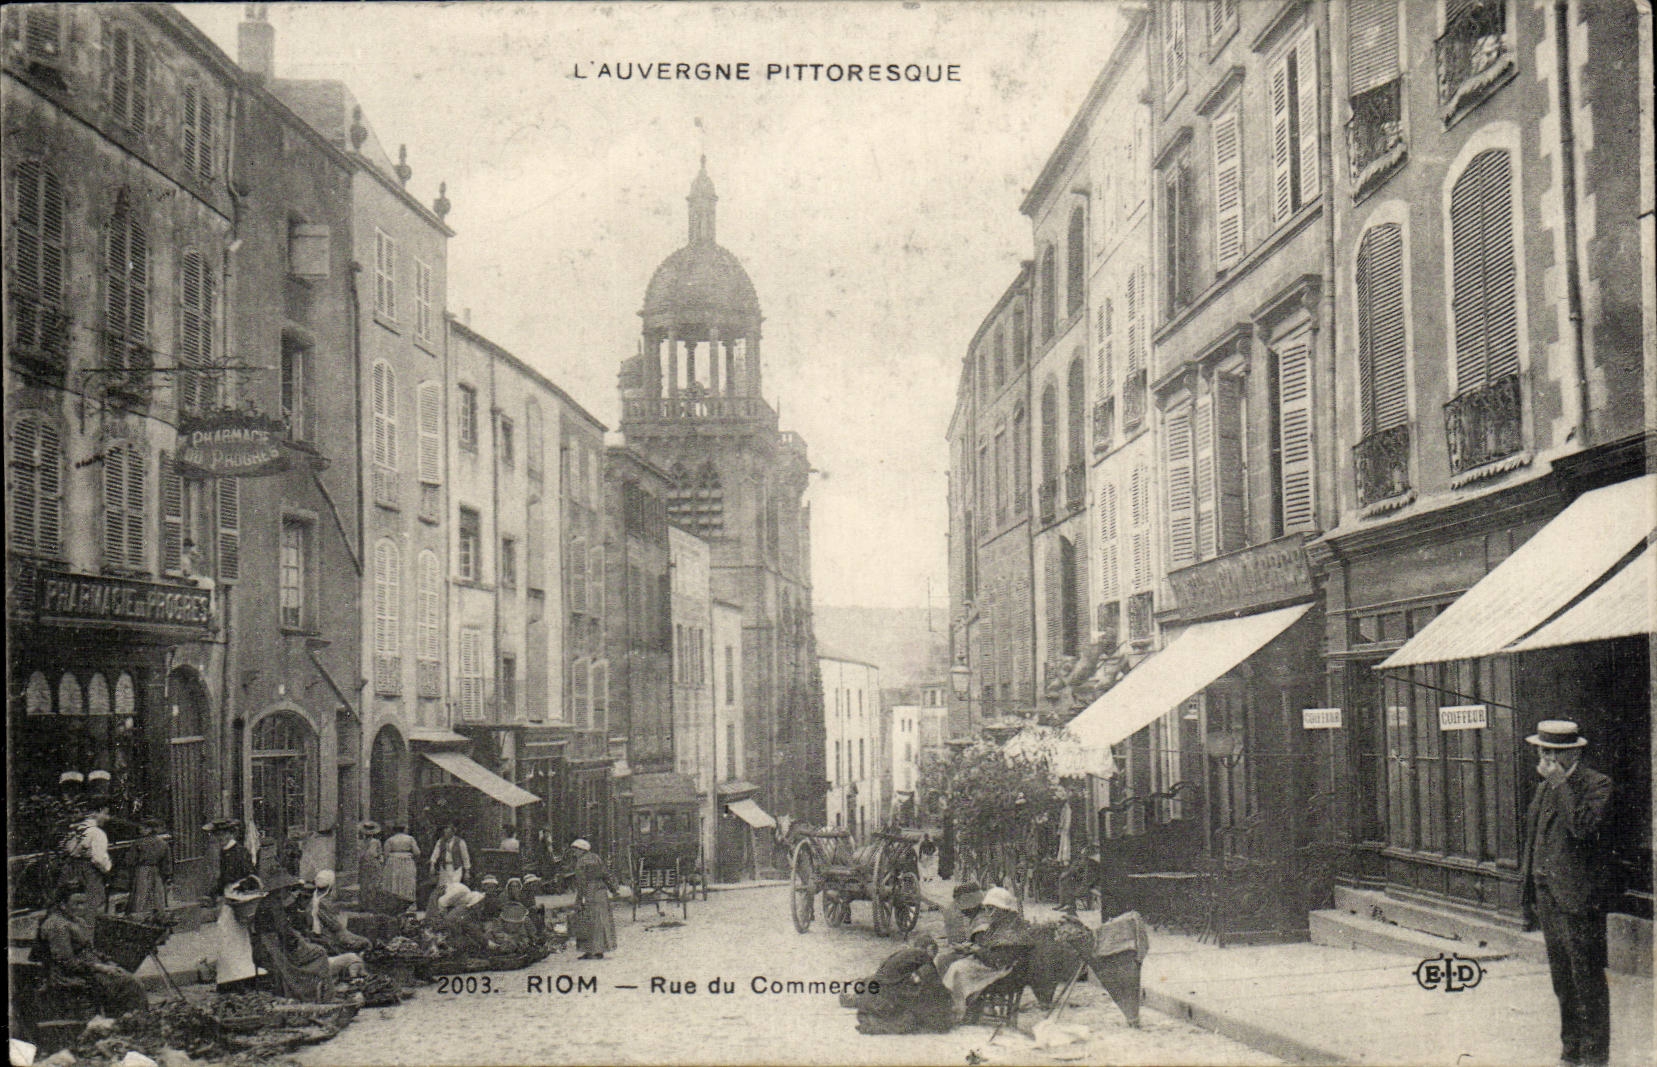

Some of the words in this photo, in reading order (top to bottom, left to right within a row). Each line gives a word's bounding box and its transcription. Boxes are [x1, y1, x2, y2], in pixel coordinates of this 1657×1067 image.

[192, 428, 271, 449] PHARMACIE
[42, 579, 138, 617] PHARMACIE
[1440, 709, 1486, 726] COIFFEUR
